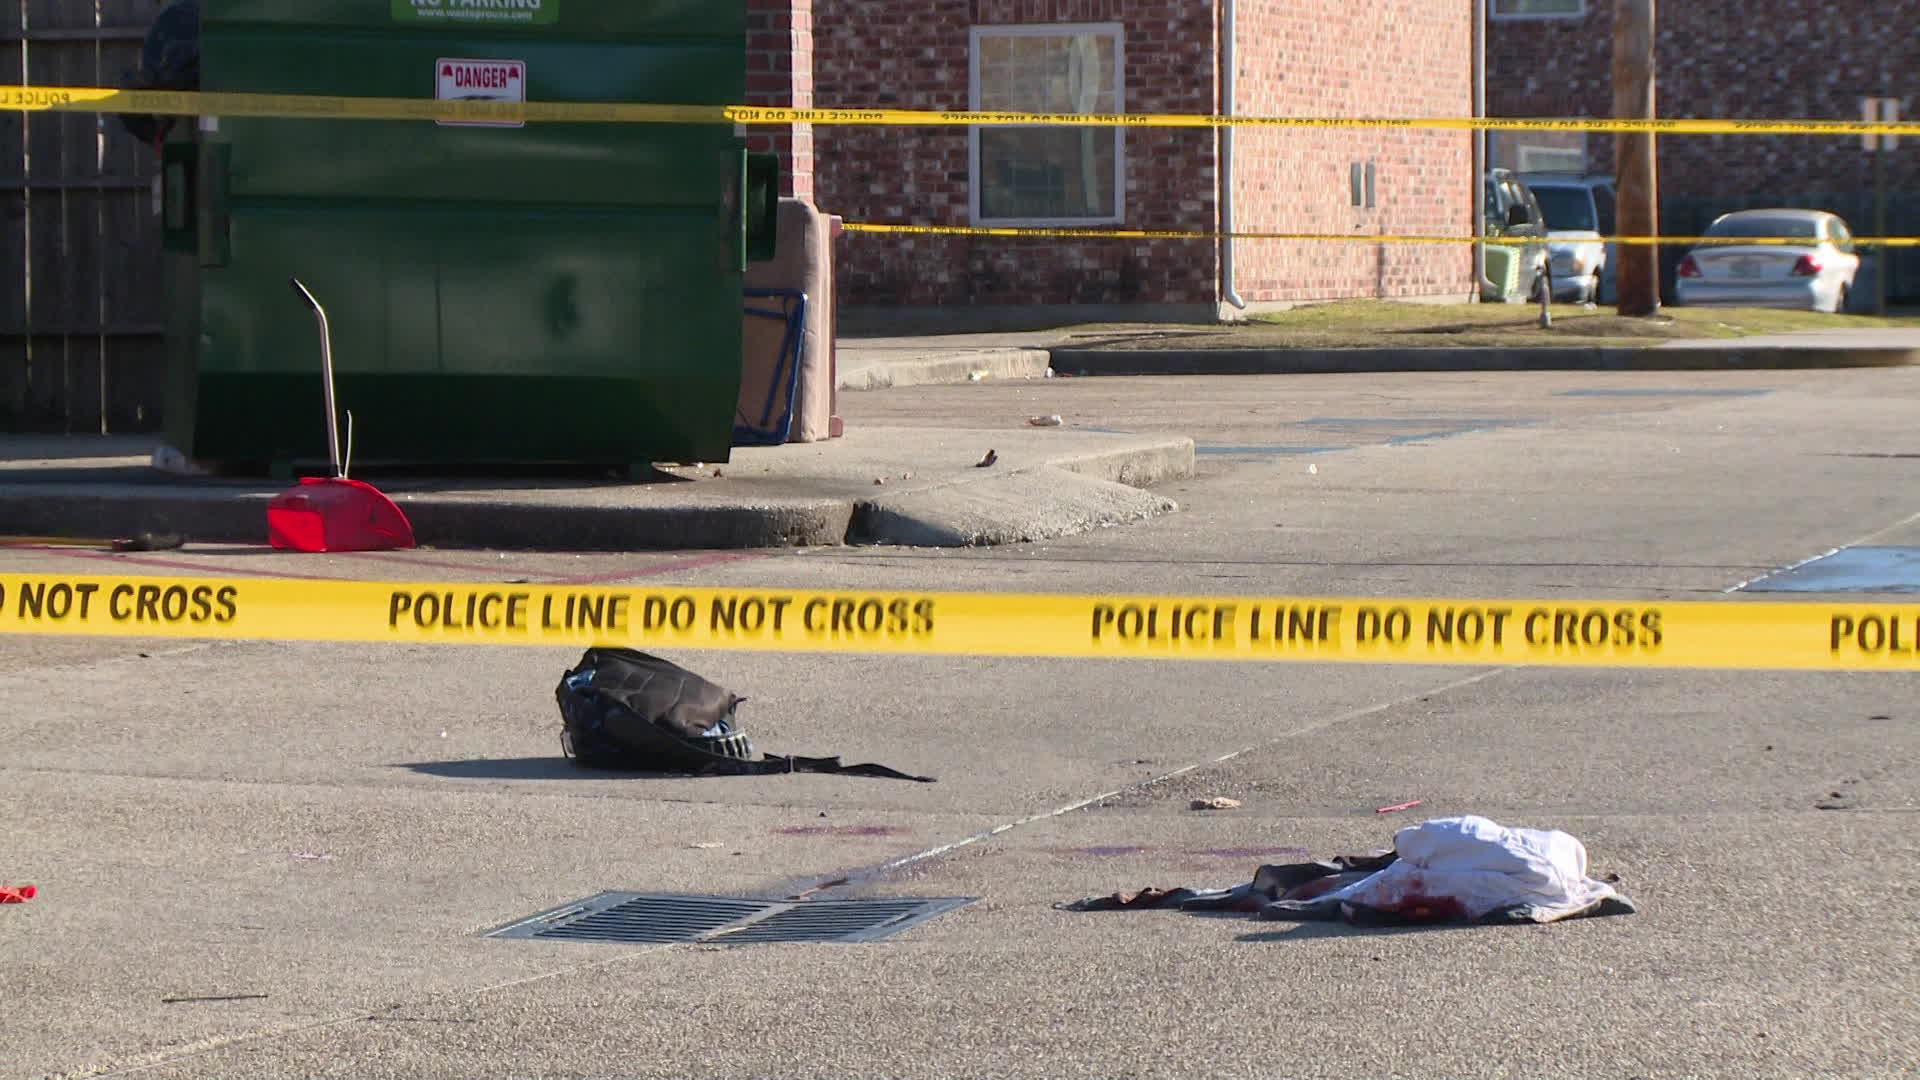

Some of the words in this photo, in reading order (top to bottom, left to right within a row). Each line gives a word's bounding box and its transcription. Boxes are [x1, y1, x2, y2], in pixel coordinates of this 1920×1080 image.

[455, 66, 507, 88] DANGER
[18, 582, 99, 619] NOT
[109, 584, 238, 622] CROSS
[388, 591, 530, 630] POLICE
[541, 593, 630, 631] LINE
[643, 594, 697, 632] DO
[709, 597, 792, 633] NOT
[803, 598, 935, 635] CROSS
[1092, 604, 1237, 641] POLICE
[1250, 606, 1342, 642] LINE
[1356, 607, 1412, 645] DO
[1426, 608, 1512, 646] NOT
[1524, 609, 1663, 648] CROSS
